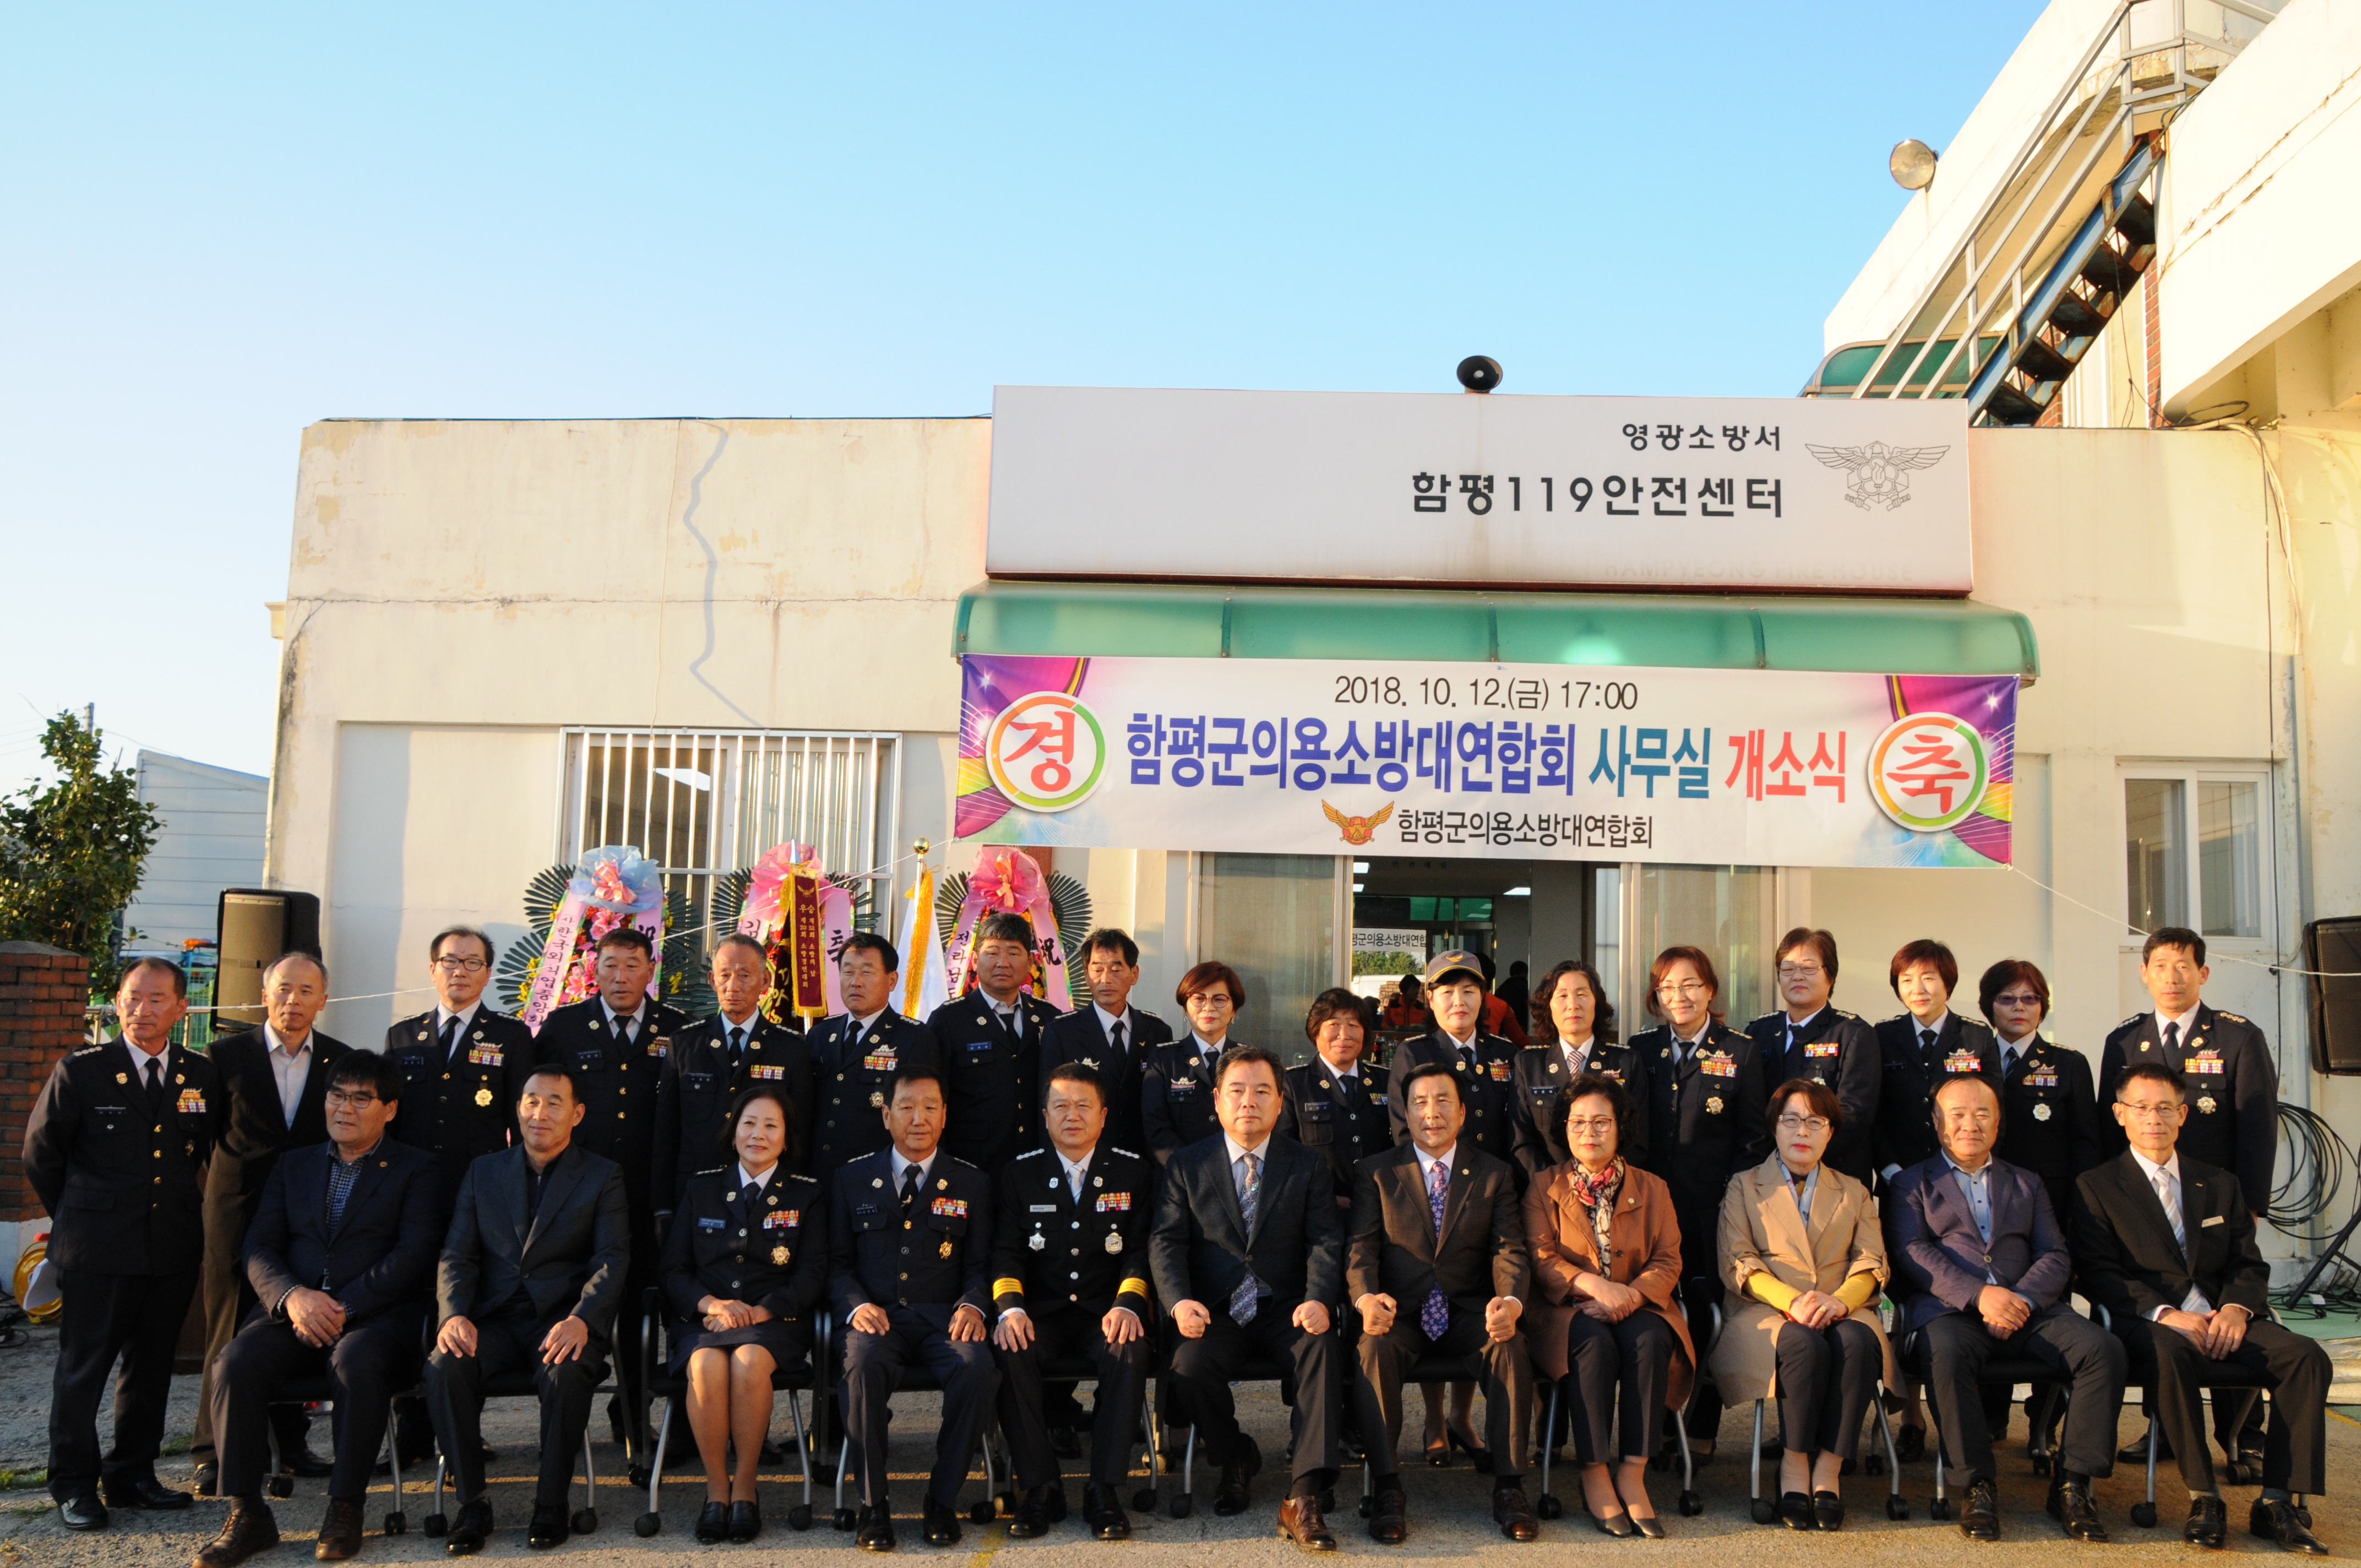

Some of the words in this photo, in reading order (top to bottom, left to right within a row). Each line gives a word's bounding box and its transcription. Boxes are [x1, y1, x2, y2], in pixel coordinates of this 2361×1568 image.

[1622, 423, 1781, 451] 영광소방서
[1412, 471, 1782, 518] 함평119안전센터
[1775, 563, 1824, 580] FIRE
[1832, 563, 1913, 582] HOUSE
[1334, 676, 1407, 707] 2018.
[1420, 677, 1457, 707] 10.
[1560, 680, 1638, 710] 17:00
[1003, 711, 1076, 792] 경
[1127, 712, 1576, 796] 함평군의용소방대연합회
[1588, 725, 1711, 799] 사무실
[1724, 728, 1847, 804] 개소식
[1886, 733, 1970, 814] 축
[1397, 809, 1653, 850] 함평군의용소방대연합회
[1038, 937, 1062, 966] 祝
